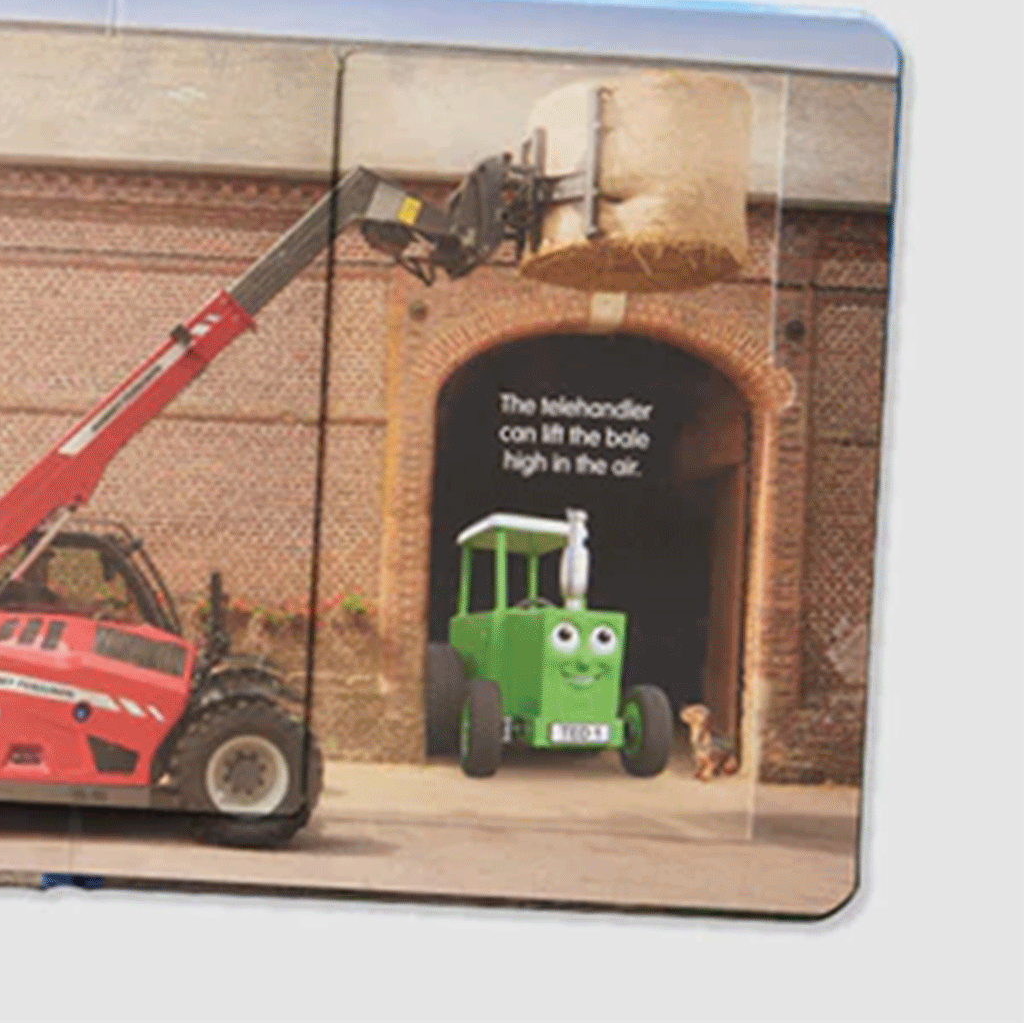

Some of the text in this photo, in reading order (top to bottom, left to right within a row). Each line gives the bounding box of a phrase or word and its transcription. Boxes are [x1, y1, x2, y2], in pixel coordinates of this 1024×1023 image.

[500, 391, 654, 421] The telehandler
[498, 422, 651, 450] can lift the bale
[502, 448, 643, 477] high in the air.
